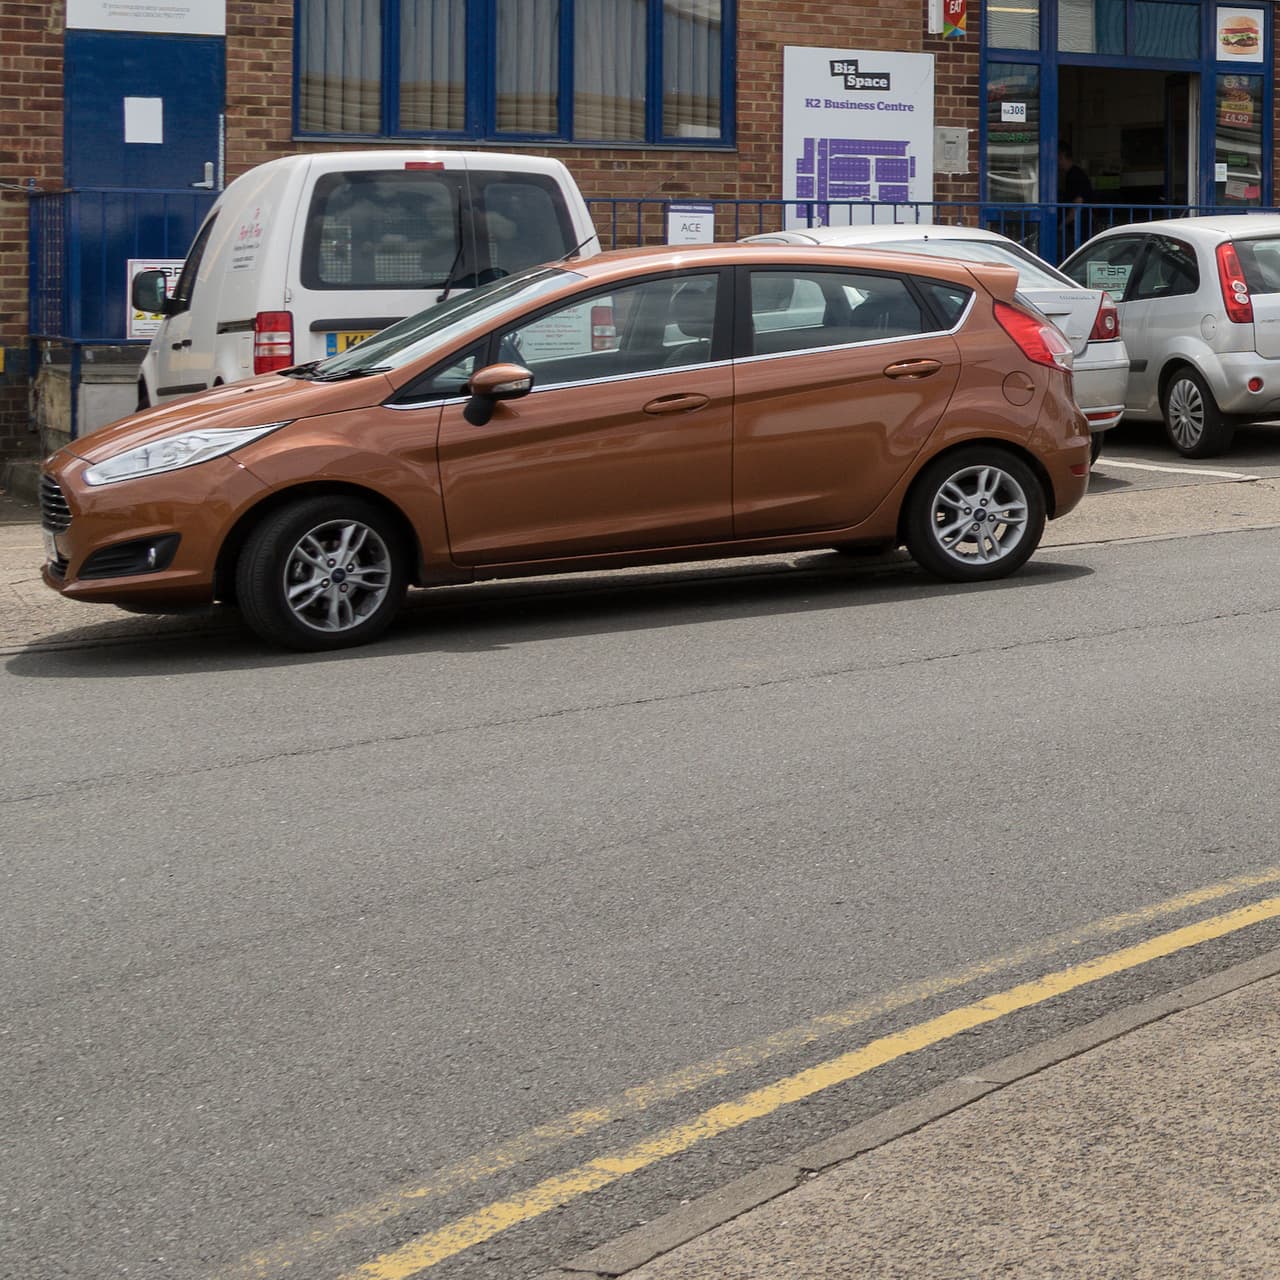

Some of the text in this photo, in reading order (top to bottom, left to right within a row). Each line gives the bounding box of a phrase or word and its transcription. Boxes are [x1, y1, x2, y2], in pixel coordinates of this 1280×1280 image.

[950, 0, 962, 14] EAT
[833, 63, 855, 74] Biz
[847, 75, 888, 88] Space
[805, 98, 914, 112] K2 Business Centre
[1010, 106, 1025, 115] 308
[681, 223, 701, 232] ACE
